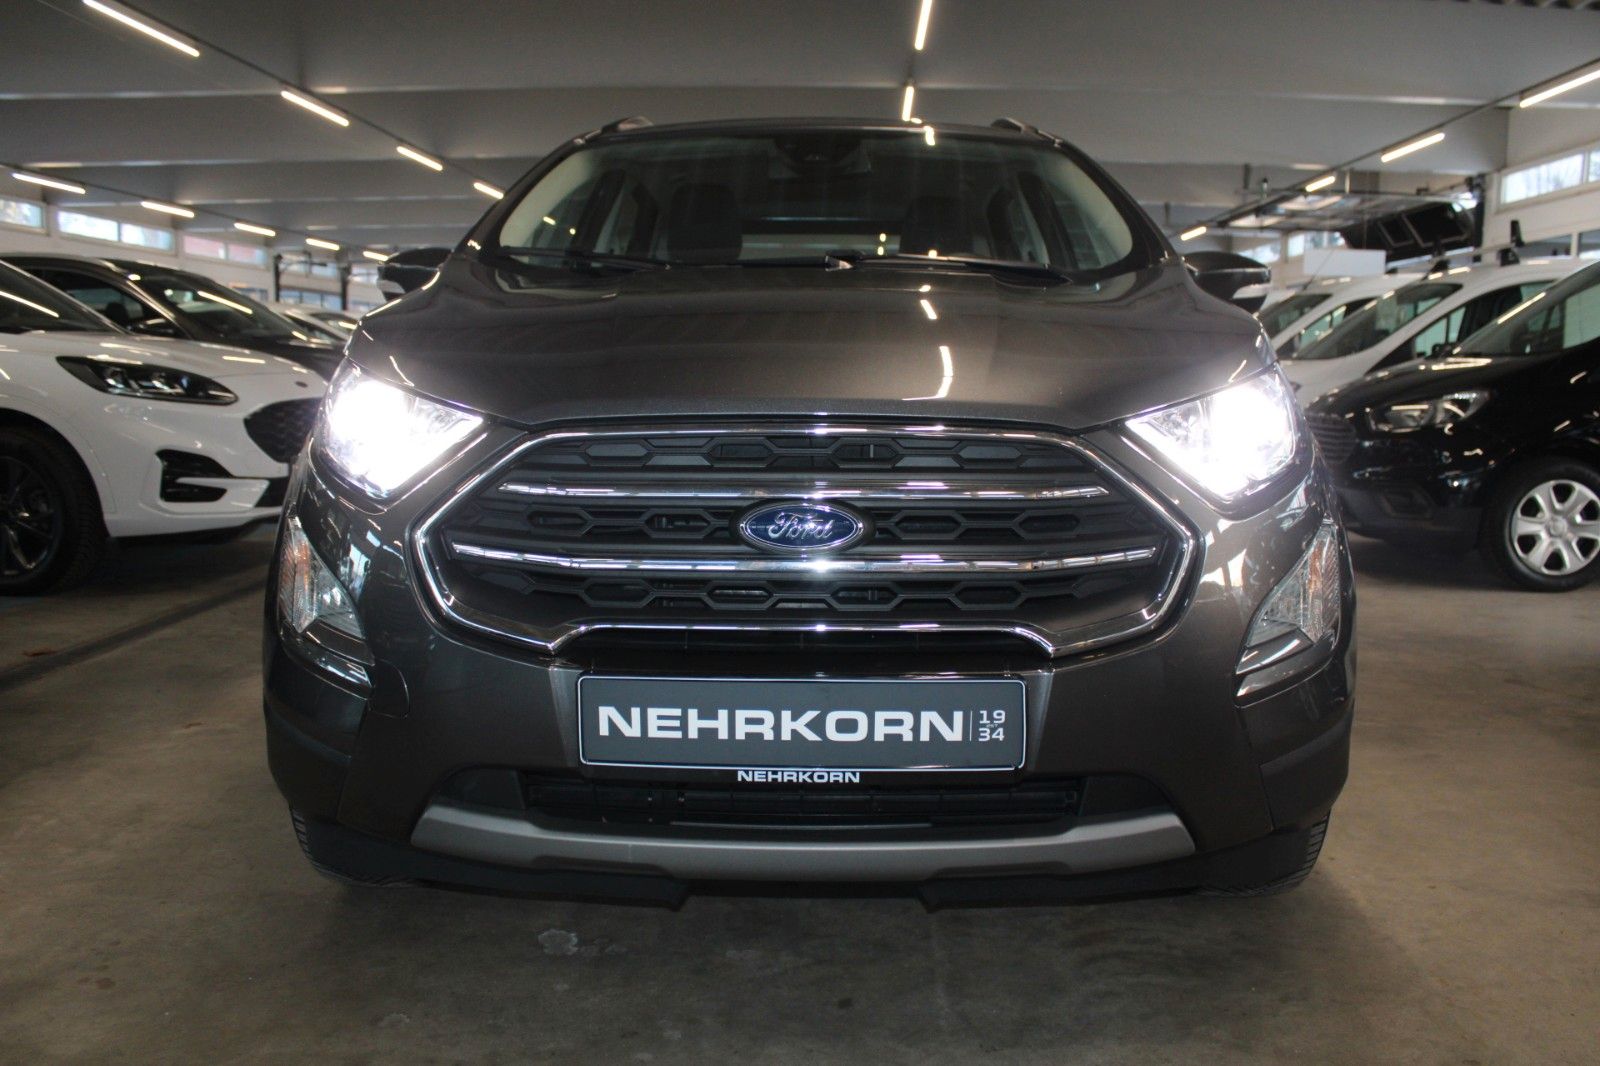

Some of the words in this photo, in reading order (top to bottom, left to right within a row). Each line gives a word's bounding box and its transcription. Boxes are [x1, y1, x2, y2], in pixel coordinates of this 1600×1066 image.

[767, 511, 834, 539] Ford
[598, 706, 963, 742] NEHRKORN
[979, 710, 1006, 724] 19
[978, 727, 1005, 742] 34
[737, 770, 860, 783] NEHRKORN
